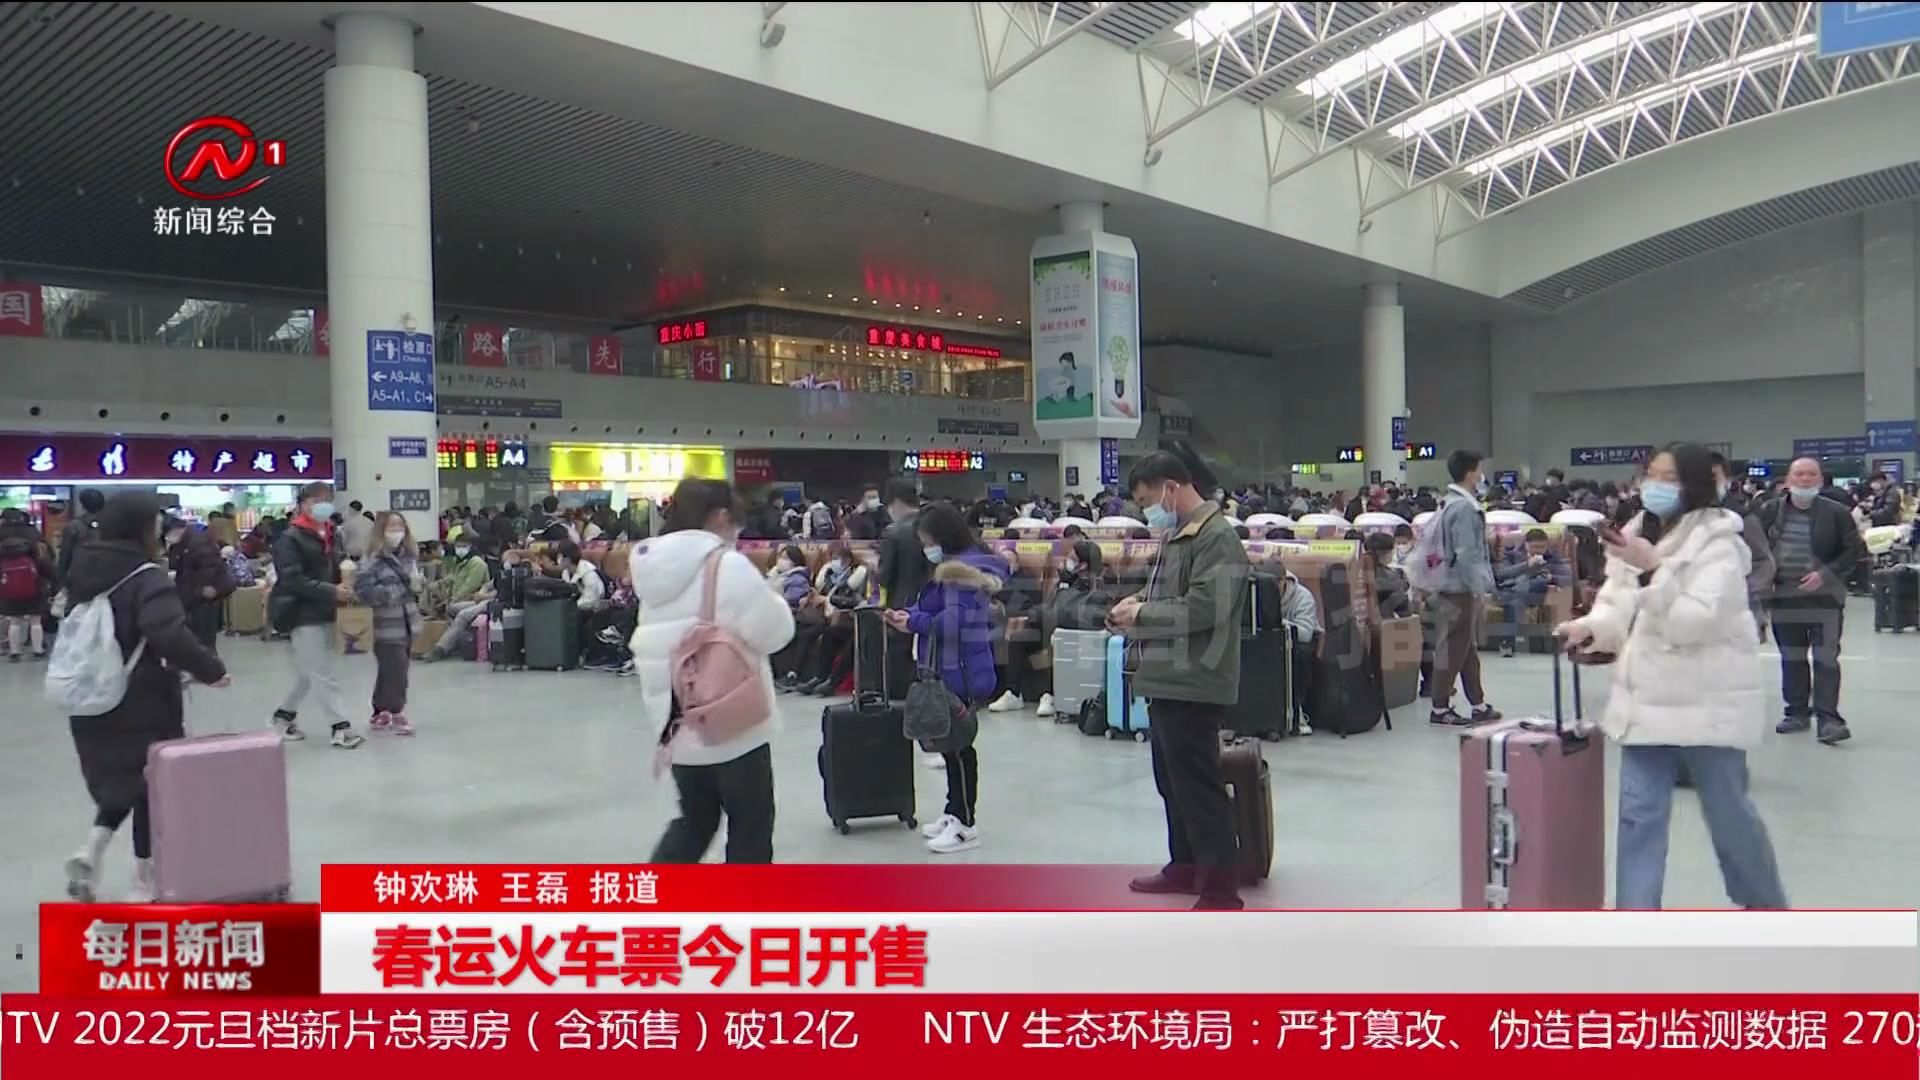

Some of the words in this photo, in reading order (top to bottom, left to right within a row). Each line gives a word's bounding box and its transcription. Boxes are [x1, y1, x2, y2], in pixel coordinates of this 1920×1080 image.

[403, 339, 433, 355] 检票口
[472, 329, 499, 356] 路
[594, 338, 618, 371] 先
[697, 350, 717, 374] 行
[485, 375, 527, 390] A5-A4
[502, 449, 526, 467] A4
[1339, 449, 1352, 460] A1
[1419, 446, 1433, 457] A1
[904, 455, 918, 469] A3
[970, 455, 983, 469] A2
